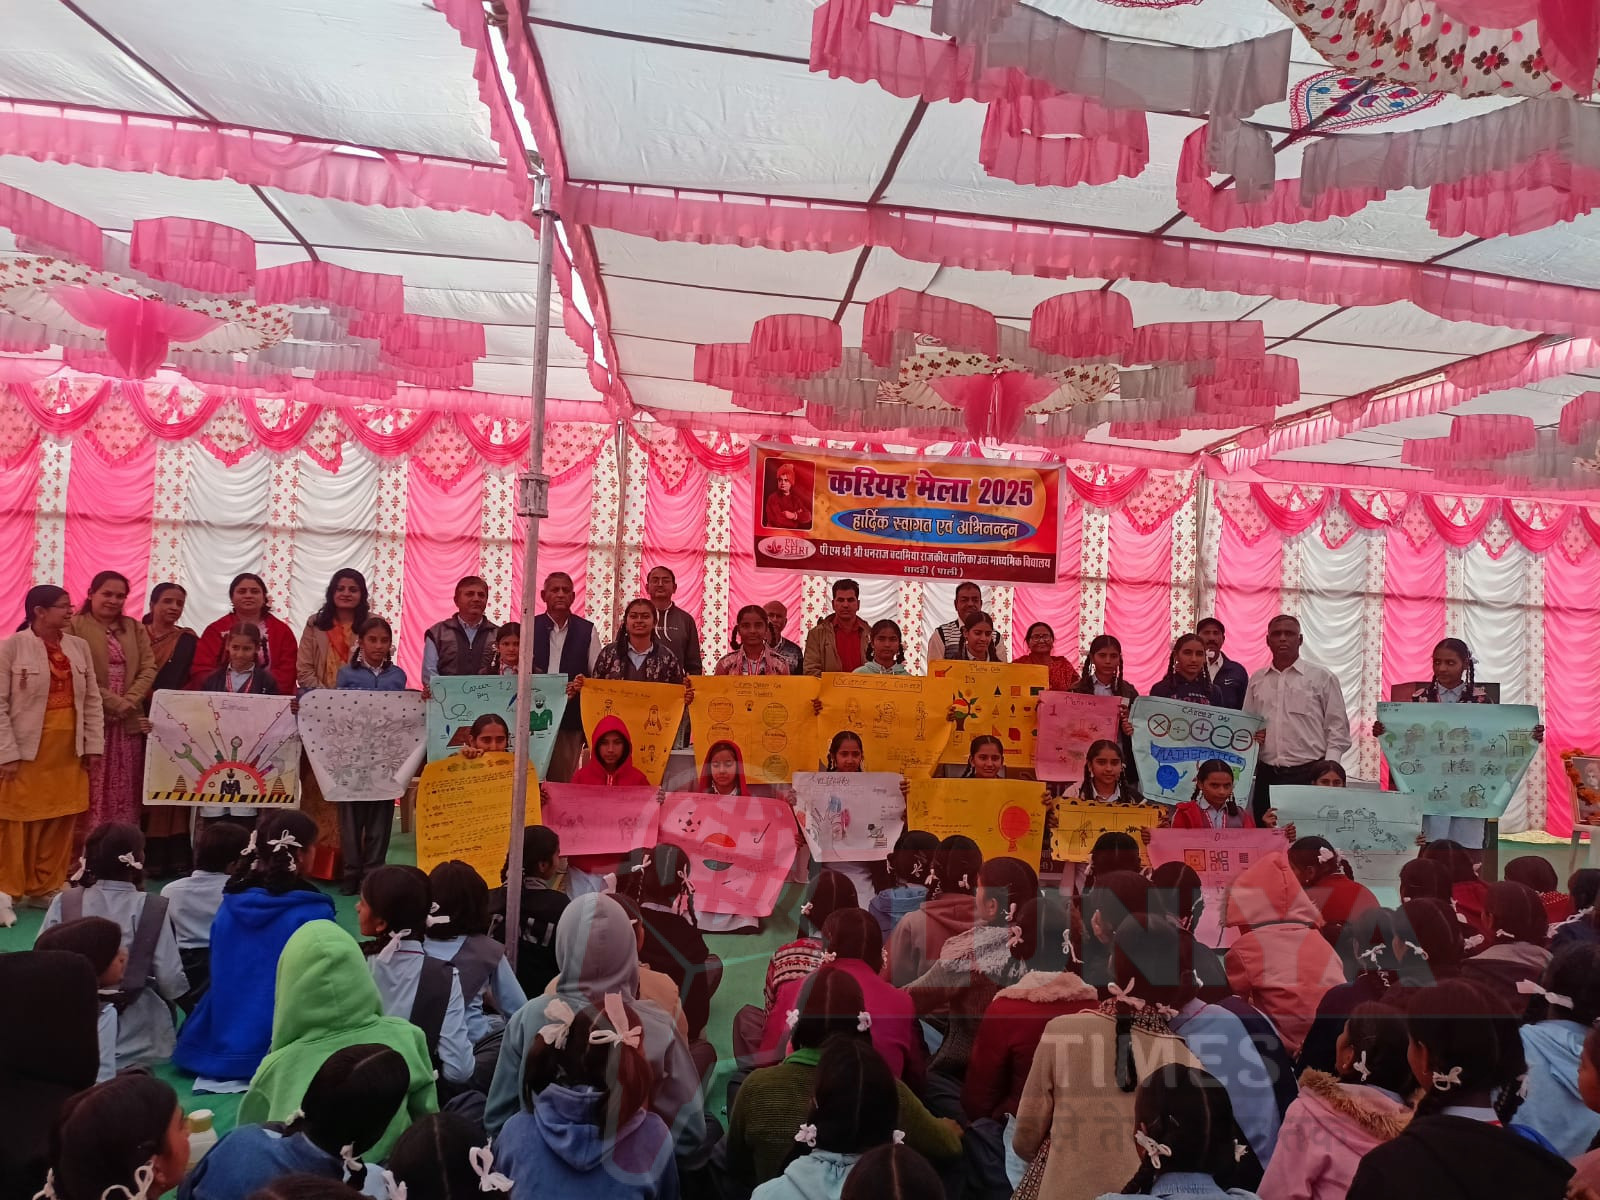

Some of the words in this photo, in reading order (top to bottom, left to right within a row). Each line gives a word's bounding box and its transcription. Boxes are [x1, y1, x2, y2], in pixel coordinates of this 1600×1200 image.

[827, 466, 910, 499] करियर
[915, 468, 972, 503] मेला
[978, 478, 1034, 507] 2025
[853, 509, 889, 532] हार्दिक
[893, 515, 932, 533] स्वागत
[935, 514, 954, 536] एवं
[957, 515, 1019, 539] अभिनन्दन
[784, 545, 809, 556] SHRI
[785, 538, 797, 546] PM
[820, 543, 828, 556] पी
[829, 546, 841, 557] एम
[841, 545, 851, 557] श्री
[853, 546, 863, 558] श्री
[920, 551, 949, 563] राजकीय
[950, 552, 976, 564] बालिका
[990, 554, 1022, 567] माध्यमिक
[1023, 555, 1051, 568] विद्यालय
[1157, 748, 1243, 765] MATHEMATICS
